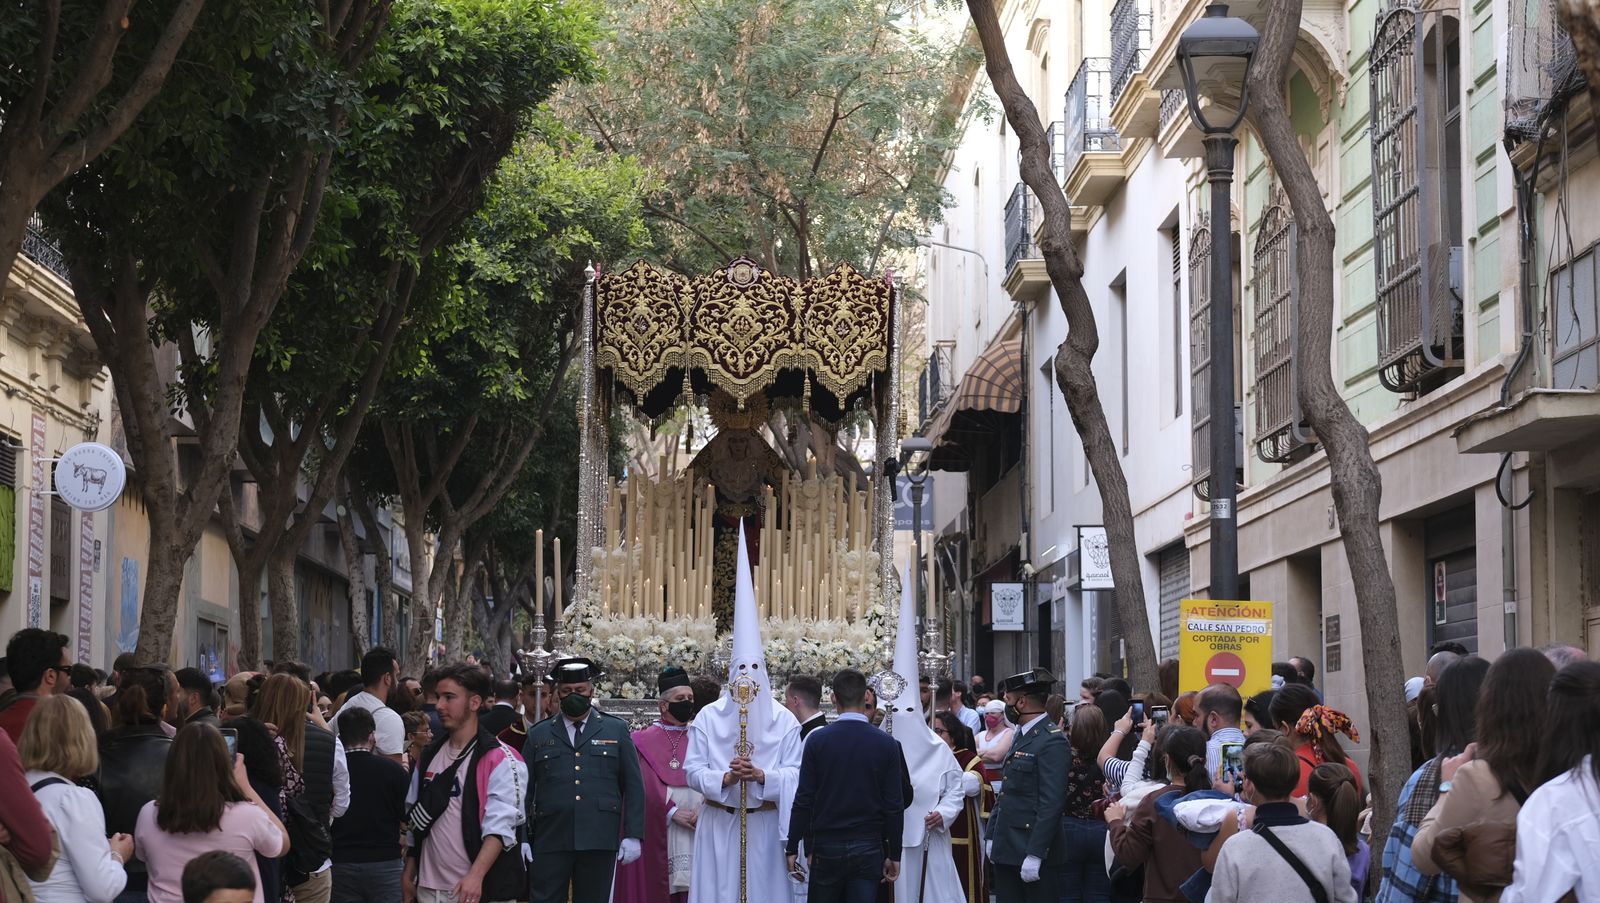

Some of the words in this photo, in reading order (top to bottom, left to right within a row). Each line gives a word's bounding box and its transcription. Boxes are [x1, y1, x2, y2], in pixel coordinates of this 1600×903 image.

[1186, 605, 1267, 618] ¡ATENCIÓN!
[1187, 623, 1213, 631] CALLE
[1215, 624, 1233, 632] SAN
[1235, 625, 1265, 633] PEDRO
[1192, 635, 1237, 643] CORTADA
[1240, 635, 1260, 643] POR
[1209, 643, 1242, 651] OBRAS
